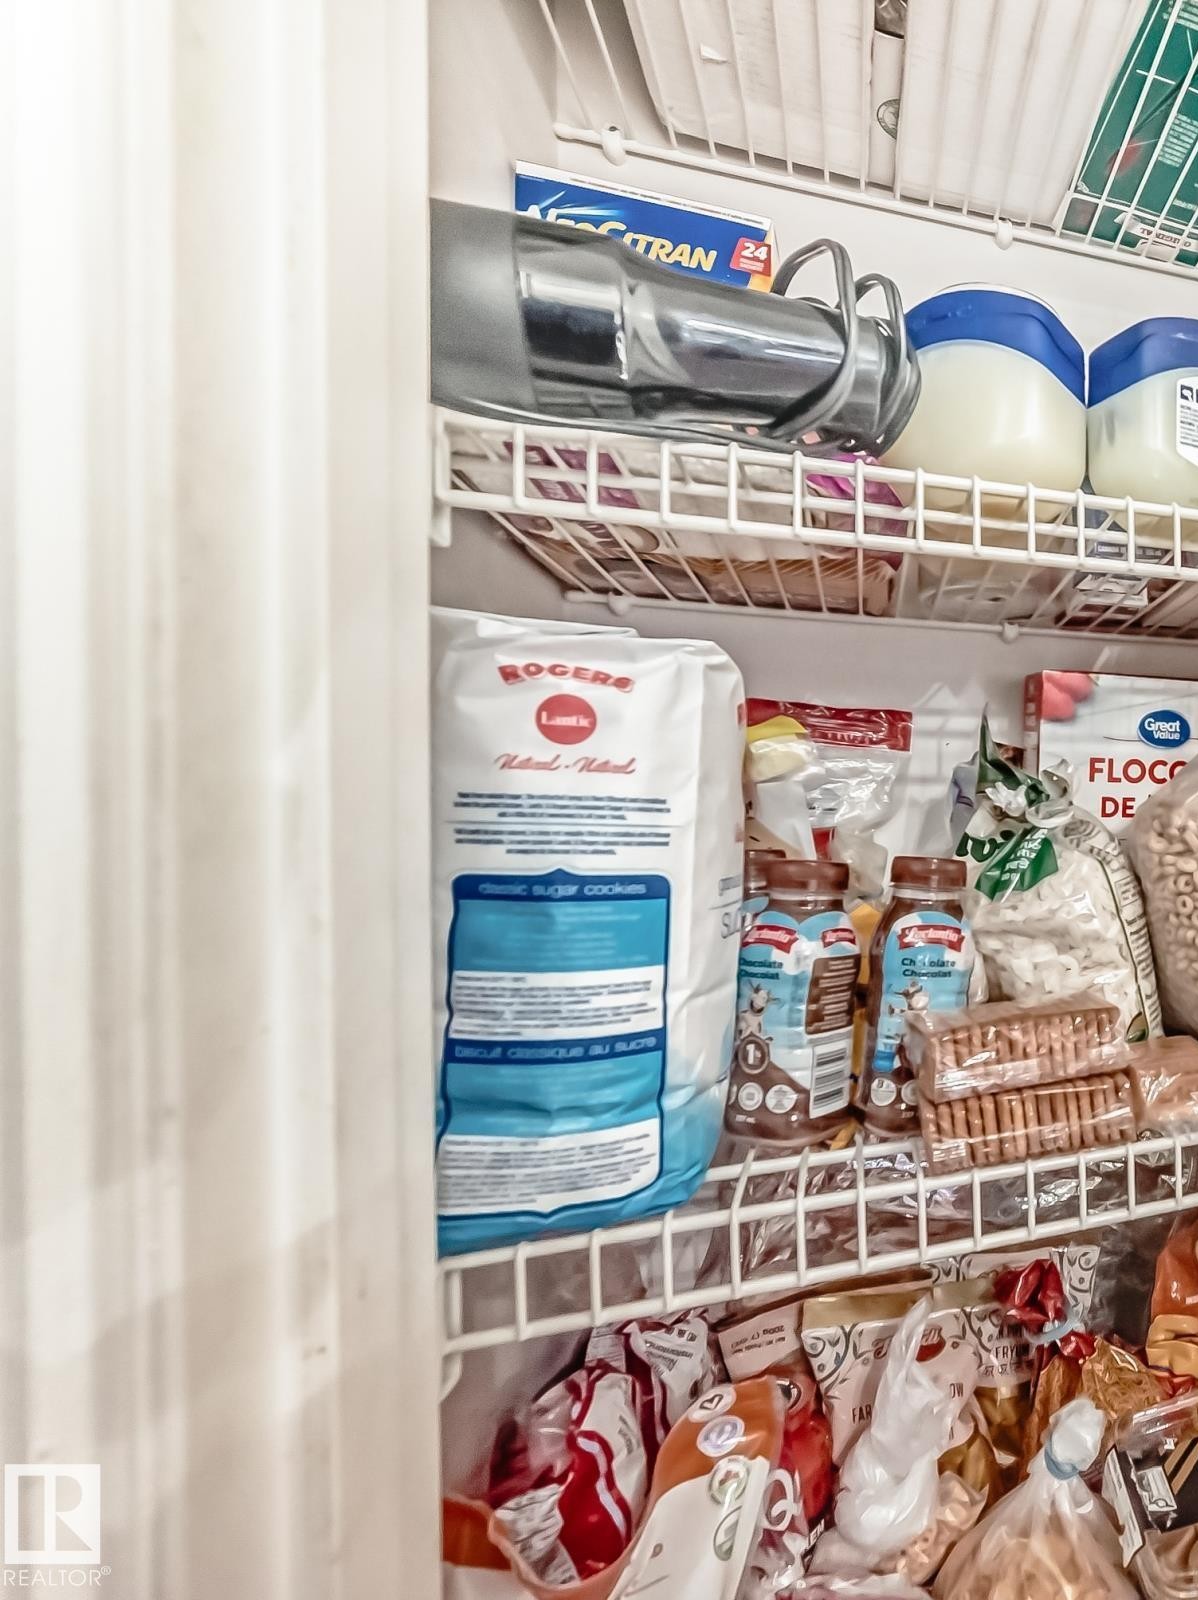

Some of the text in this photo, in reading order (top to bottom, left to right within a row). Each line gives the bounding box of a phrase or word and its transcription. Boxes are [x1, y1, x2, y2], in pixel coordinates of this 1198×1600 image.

[515, 205, 718, 272] CITRAN
[741, 243, 769, 261] 24
[497, 661, 637, 693] ROGERS
[1143, 717, 1181, 733] Great
[1152, 730, 1181, 740] Value
[1101, 796, 1136, 818] DE
[583, 882, 648, 896] cookies
[901, 957, 957, 968] Cholate
